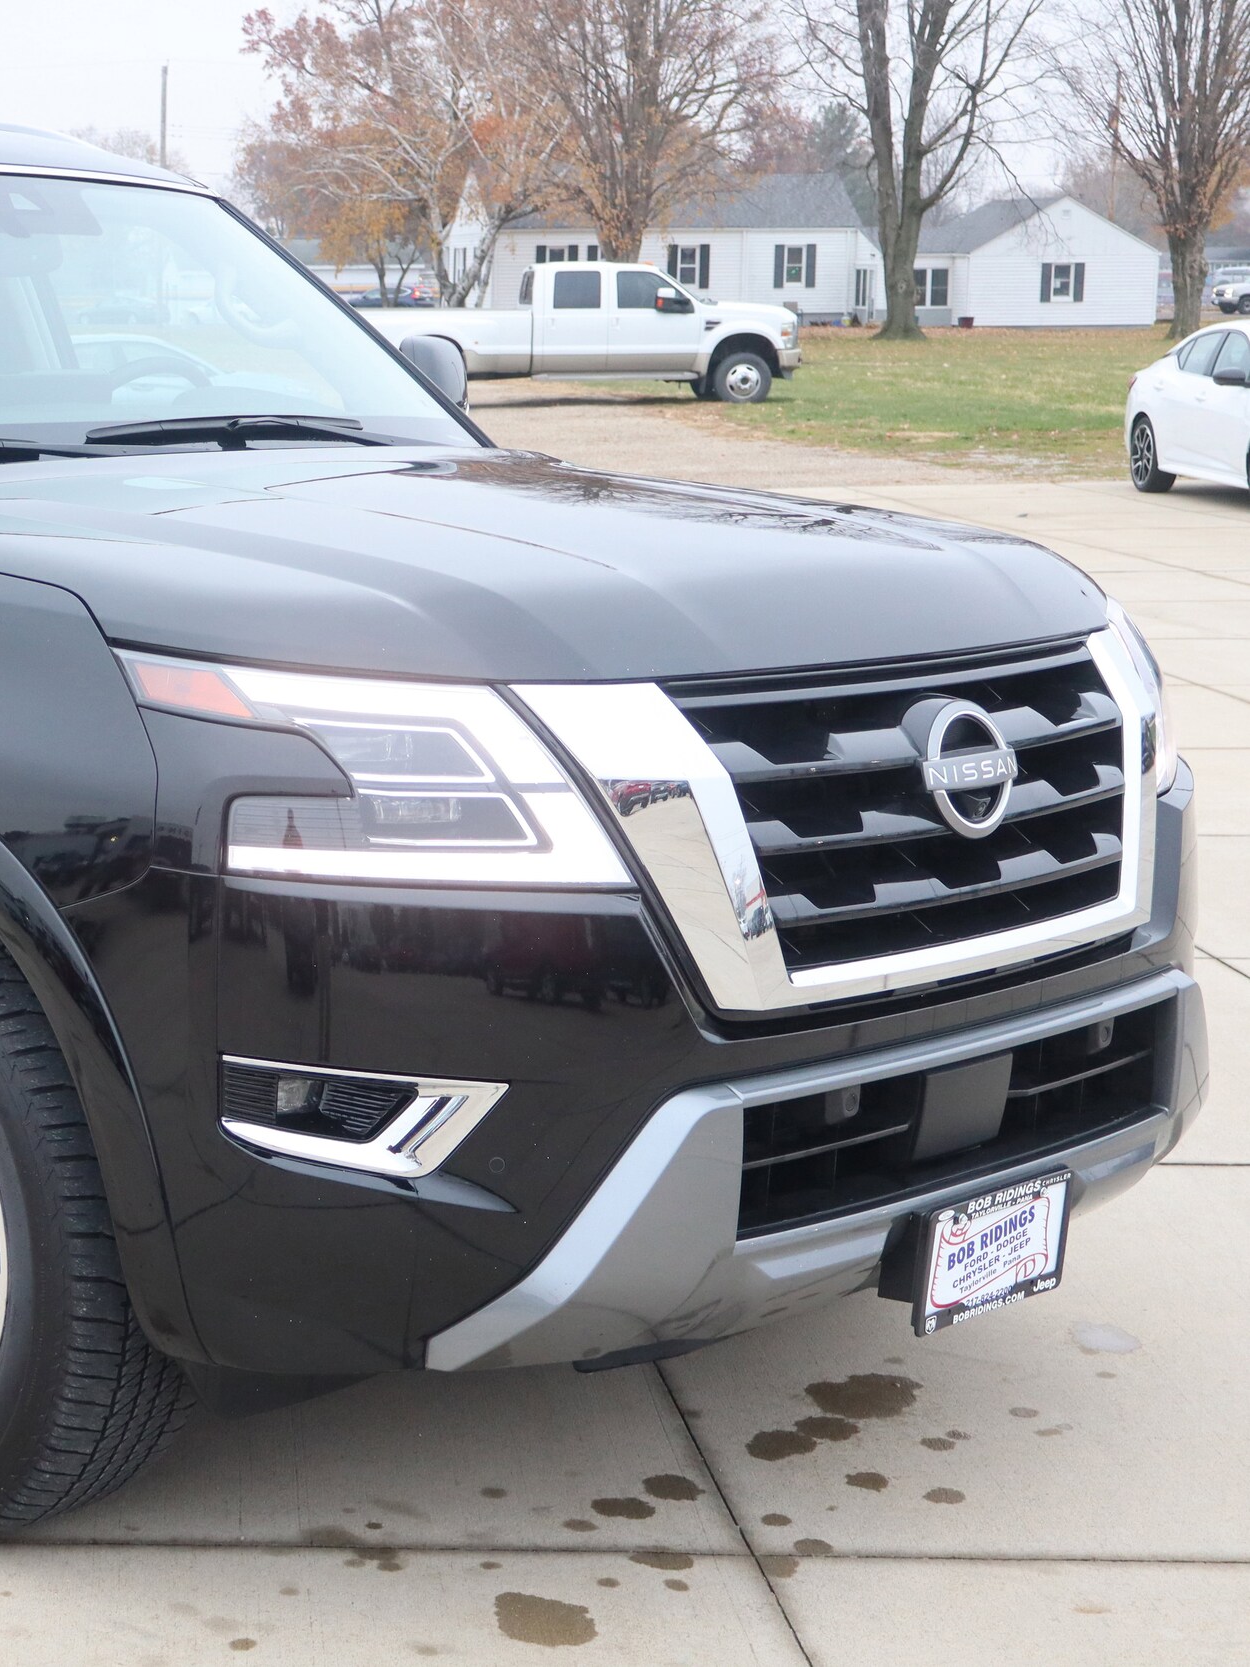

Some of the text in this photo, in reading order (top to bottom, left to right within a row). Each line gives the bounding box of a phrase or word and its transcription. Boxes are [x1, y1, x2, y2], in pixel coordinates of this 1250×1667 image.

[929, 756, 1017, 785] NISSAN
[967, 1173, 1072, 1214] BOB RIDINGS CHRYSLER
[971, 1201, 1011, 1219] TAYLORVILLE
[947, 1205, 1035, 1271] BOB RIDINGS
[964, 1251, 989, 1272] FORD
[996, 1228, 1028, 1252] DODGE
[952, 1254, 1000, 1288] CHRYSLER
[1008, 1237, 1031, 1256] JEEP
[959, 1254, 1021, 1294] Taylorville Pana
[1033, 1277, 1057, 1292] Jeep
[952, 1291, 1025, 1325] BOBRIDINGS.COM
